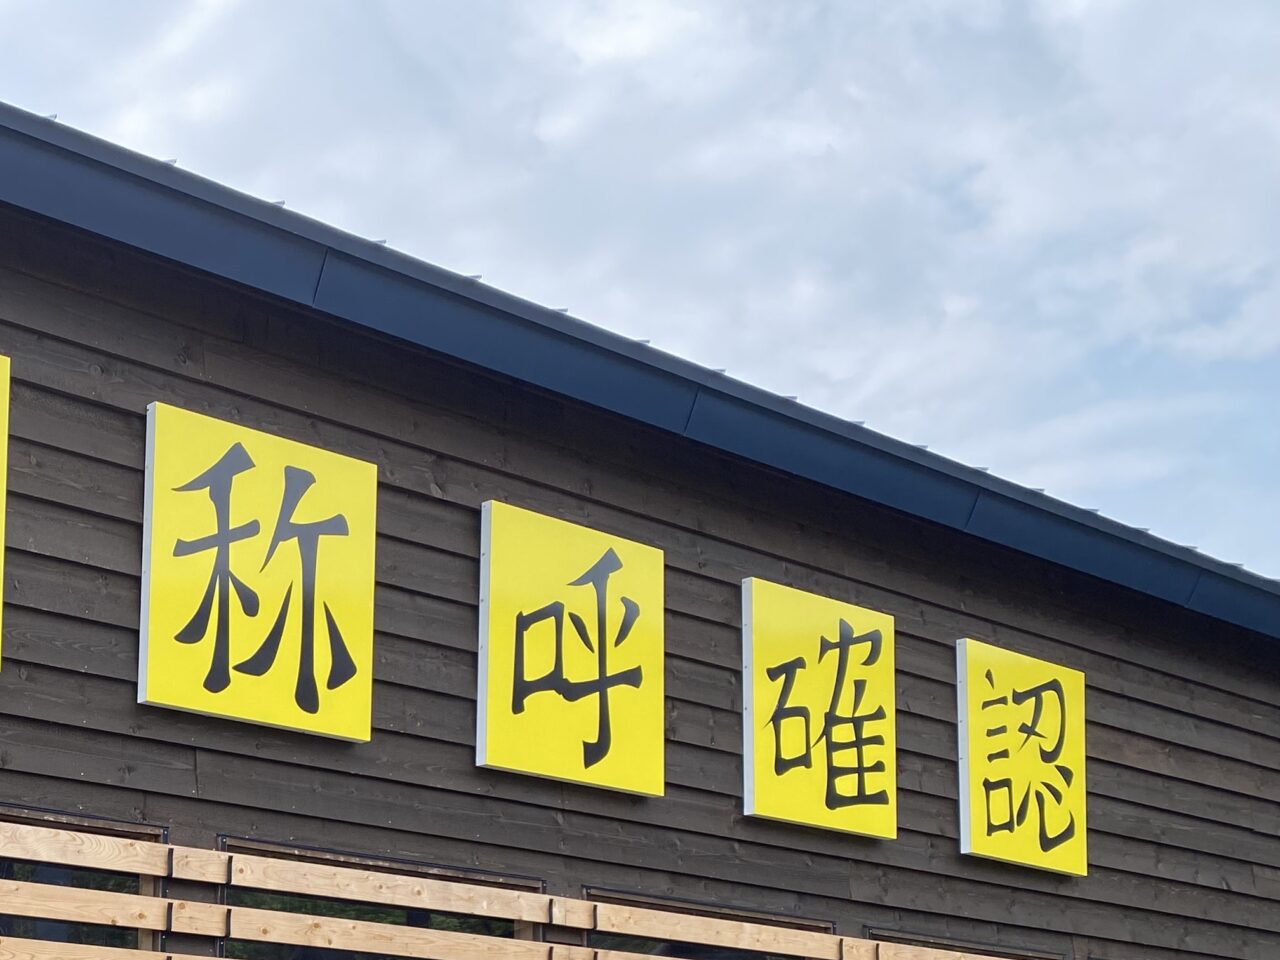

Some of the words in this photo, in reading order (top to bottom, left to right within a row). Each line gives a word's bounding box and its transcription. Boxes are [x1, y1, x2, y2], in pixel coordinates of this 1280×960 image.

[172, 443, 357, 714] 称
[512, 548, 642, 769] 呼
[766, 619, 889, 810] 確
[982, 670, 1074, 852] 認
